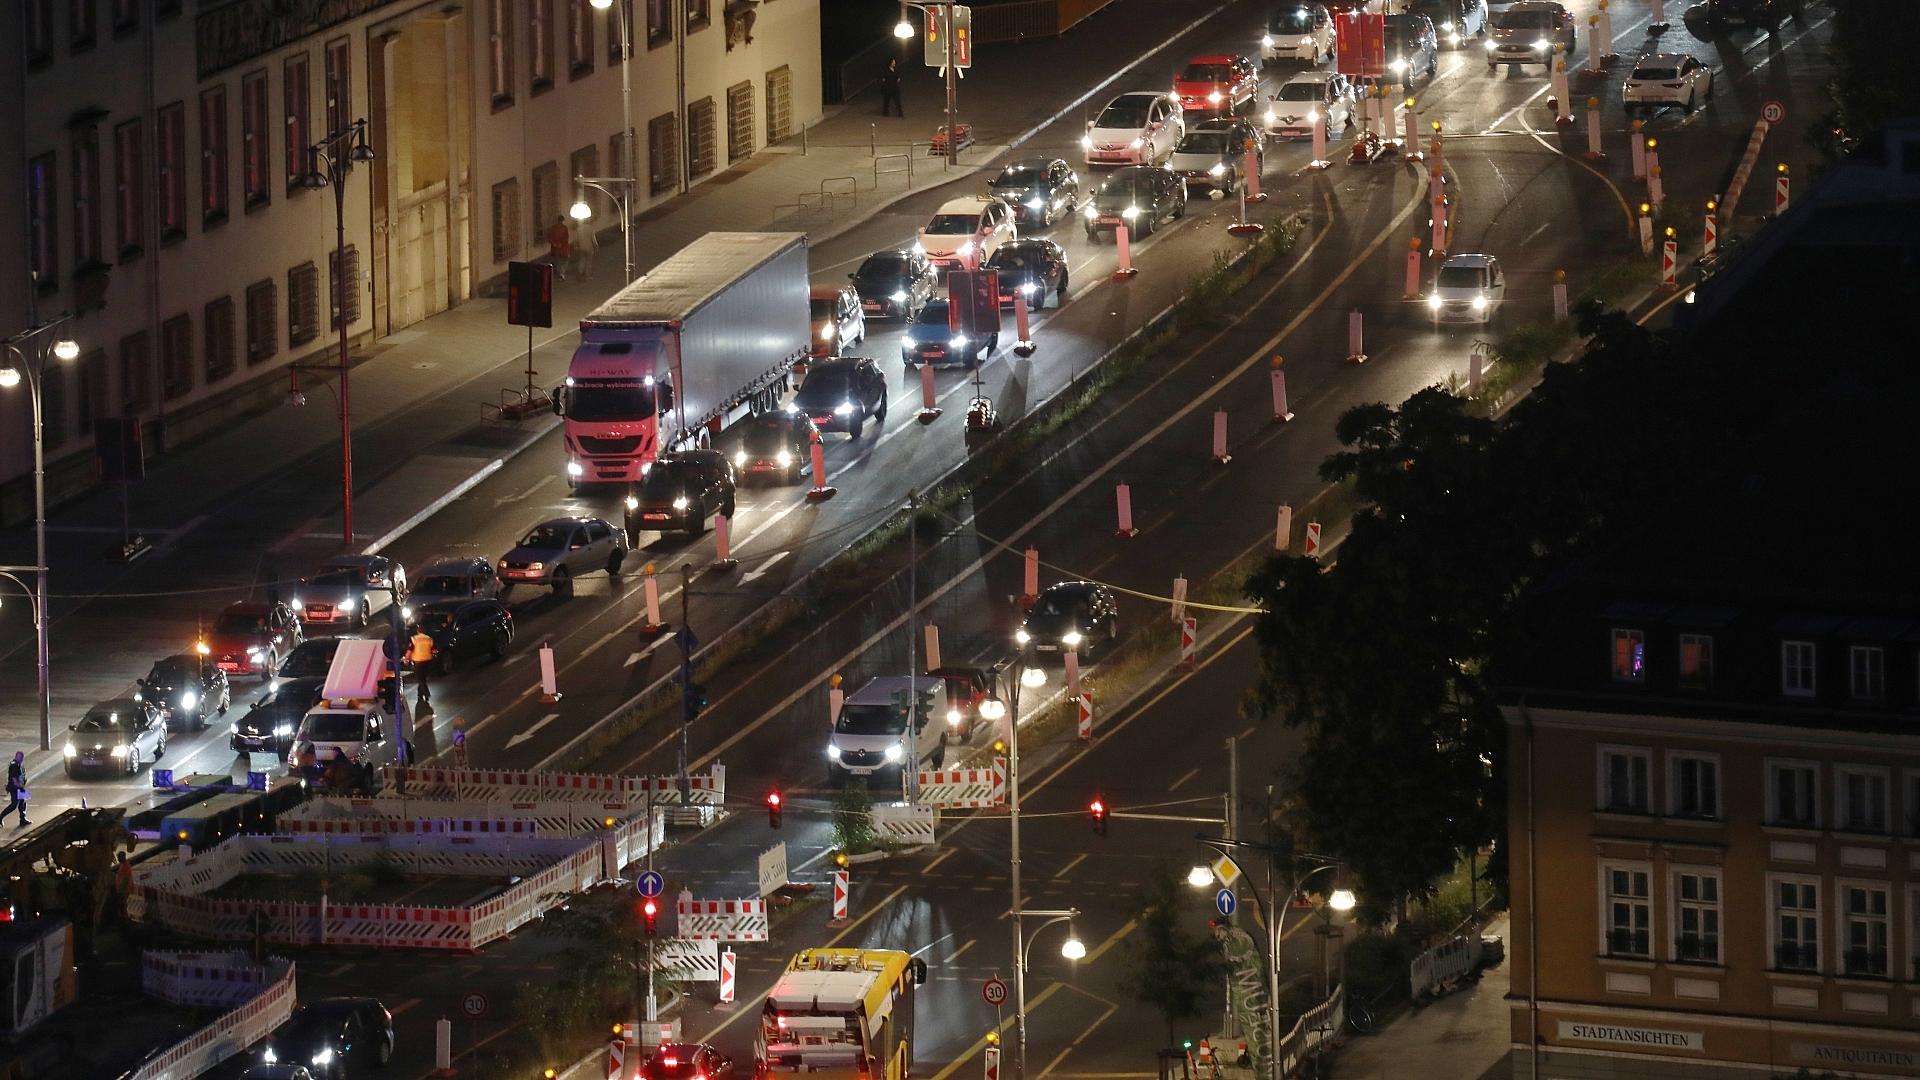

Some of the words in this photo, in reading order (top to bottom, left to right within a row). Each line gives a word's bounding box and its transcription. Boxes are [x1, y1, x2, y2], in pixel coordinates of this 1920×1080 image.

[988, 986, 1002, 998] 30
[468, 999, 483, 1010] 30
[1573, 1025, 1689, 1046] STADTANSICHTEN
